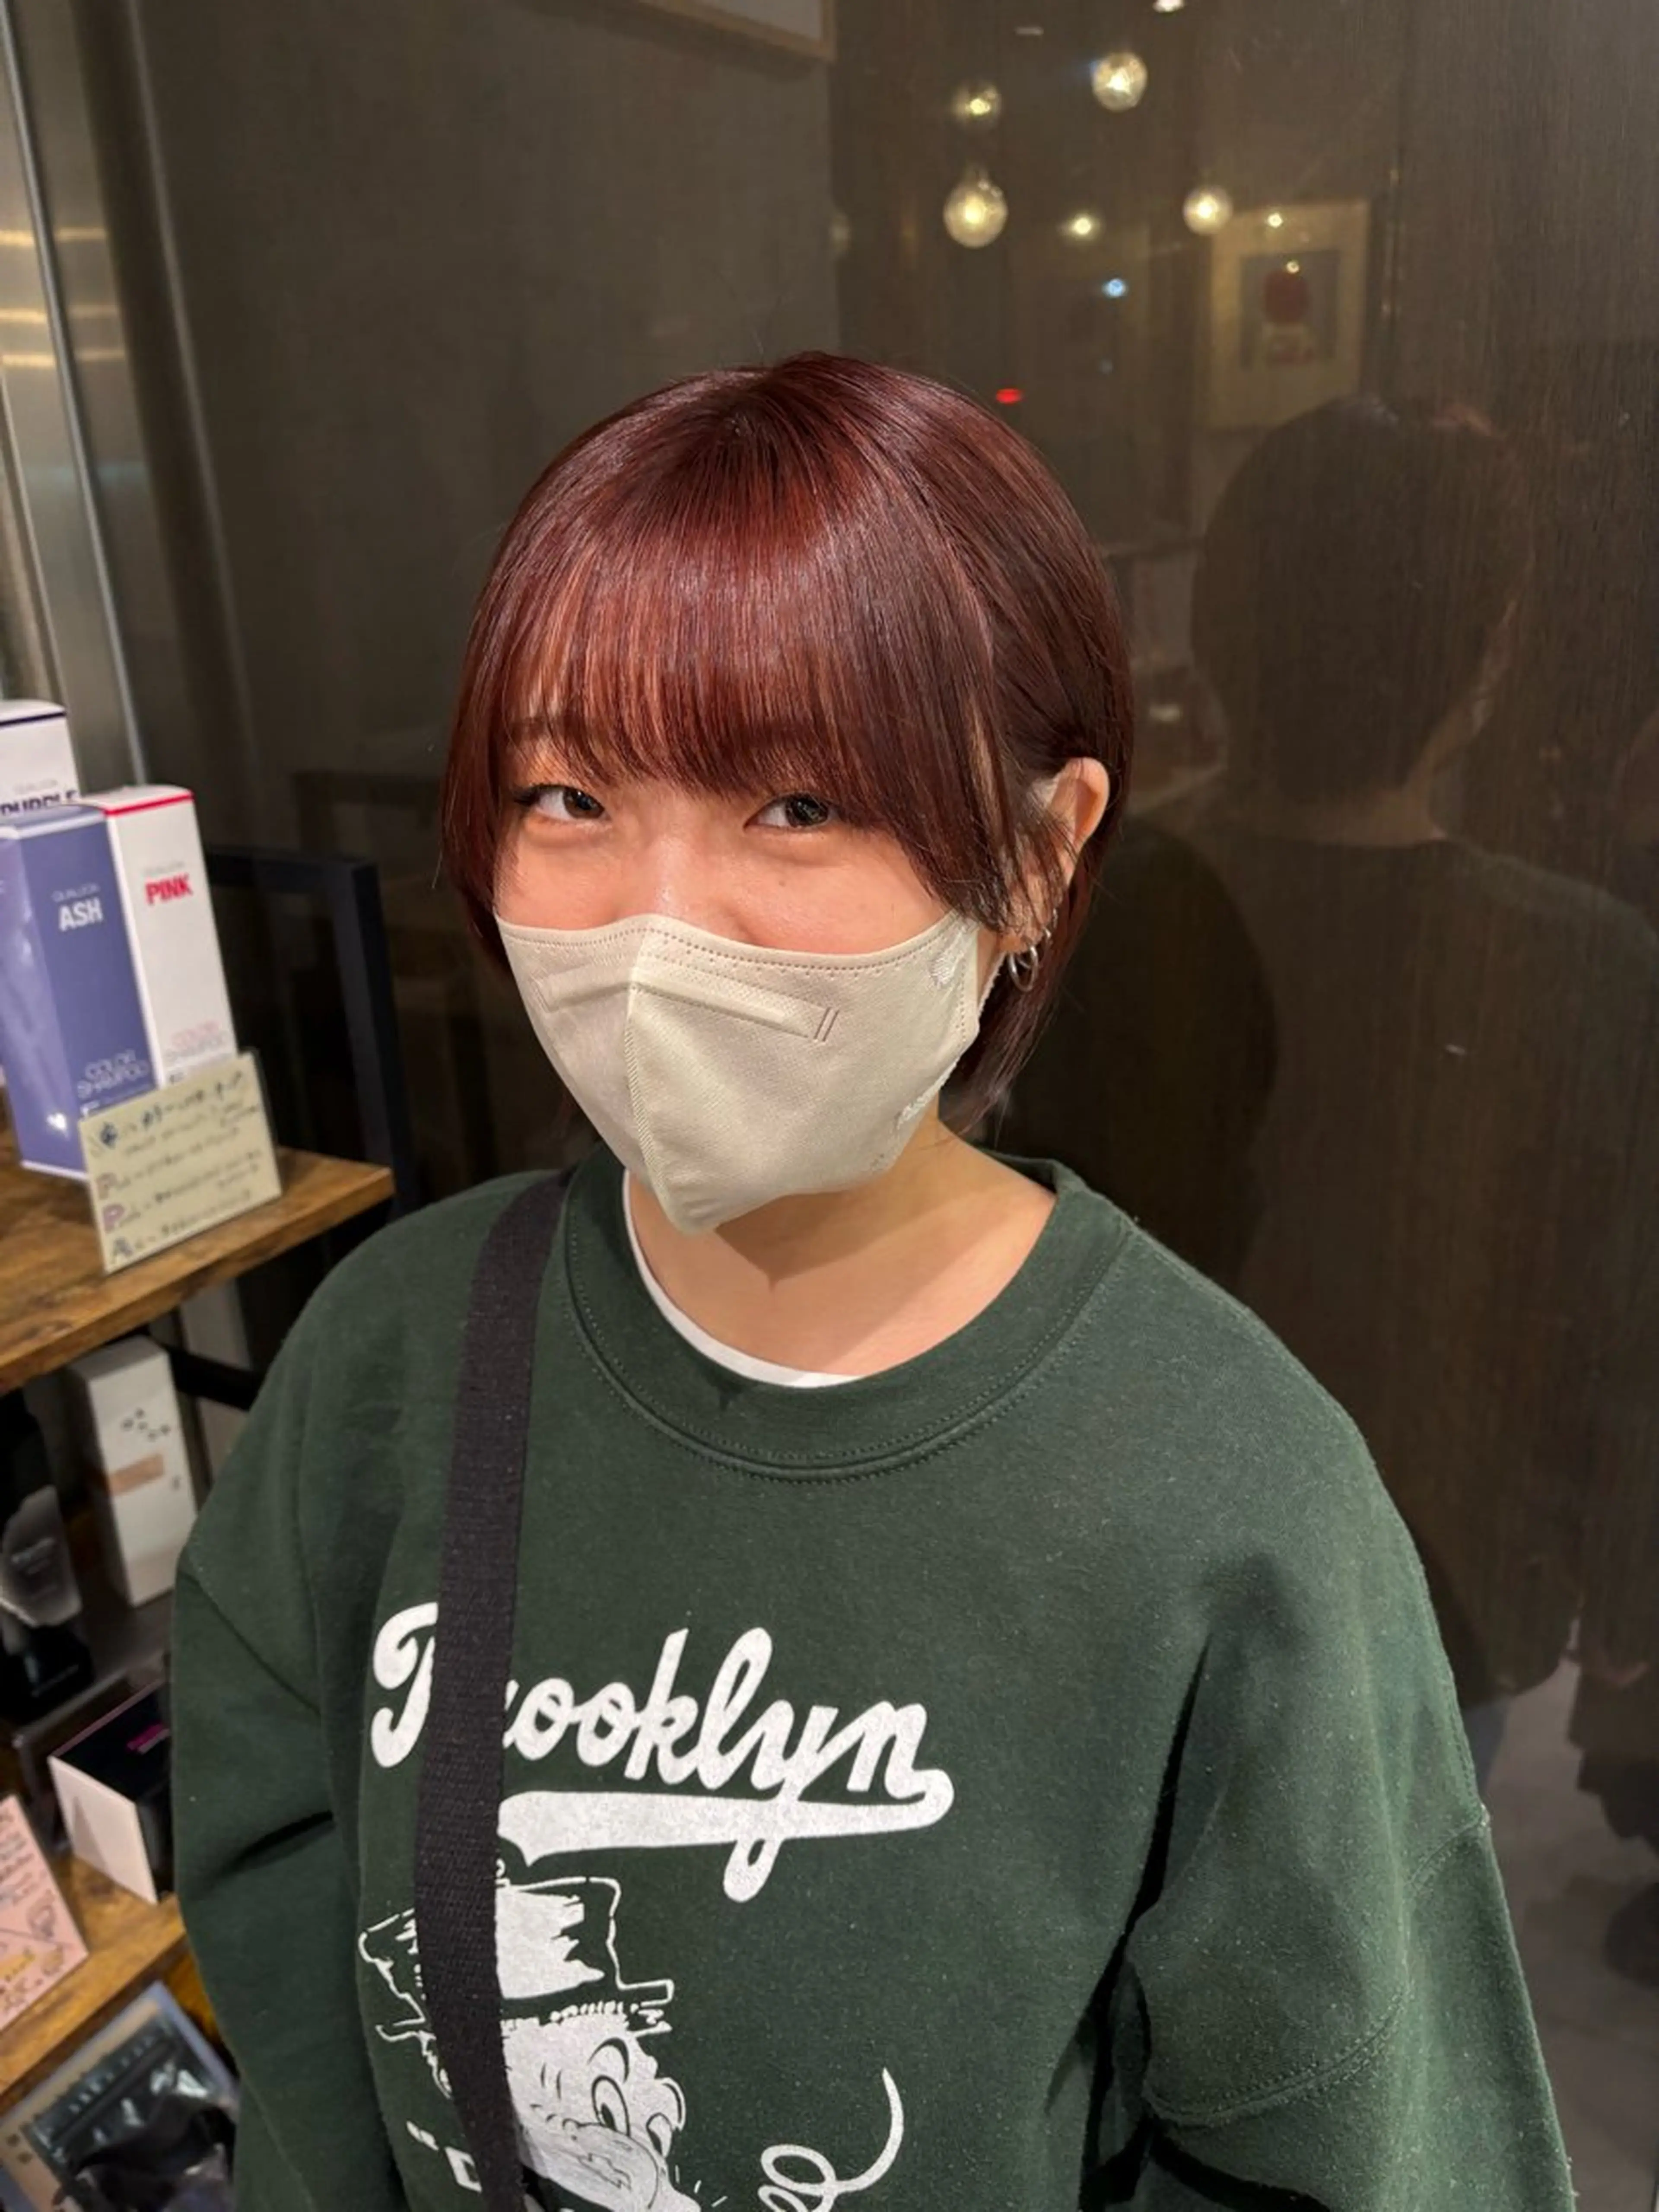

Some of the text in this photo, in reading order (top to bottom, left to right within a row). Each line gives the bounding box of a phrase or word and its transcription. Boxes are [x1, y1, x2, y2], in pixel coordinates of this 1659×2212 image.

[145, 873, 194, 906] PINK
[59, 896, 103, 931] ASH
[371, 1602, 954, 1902] ooklyn
